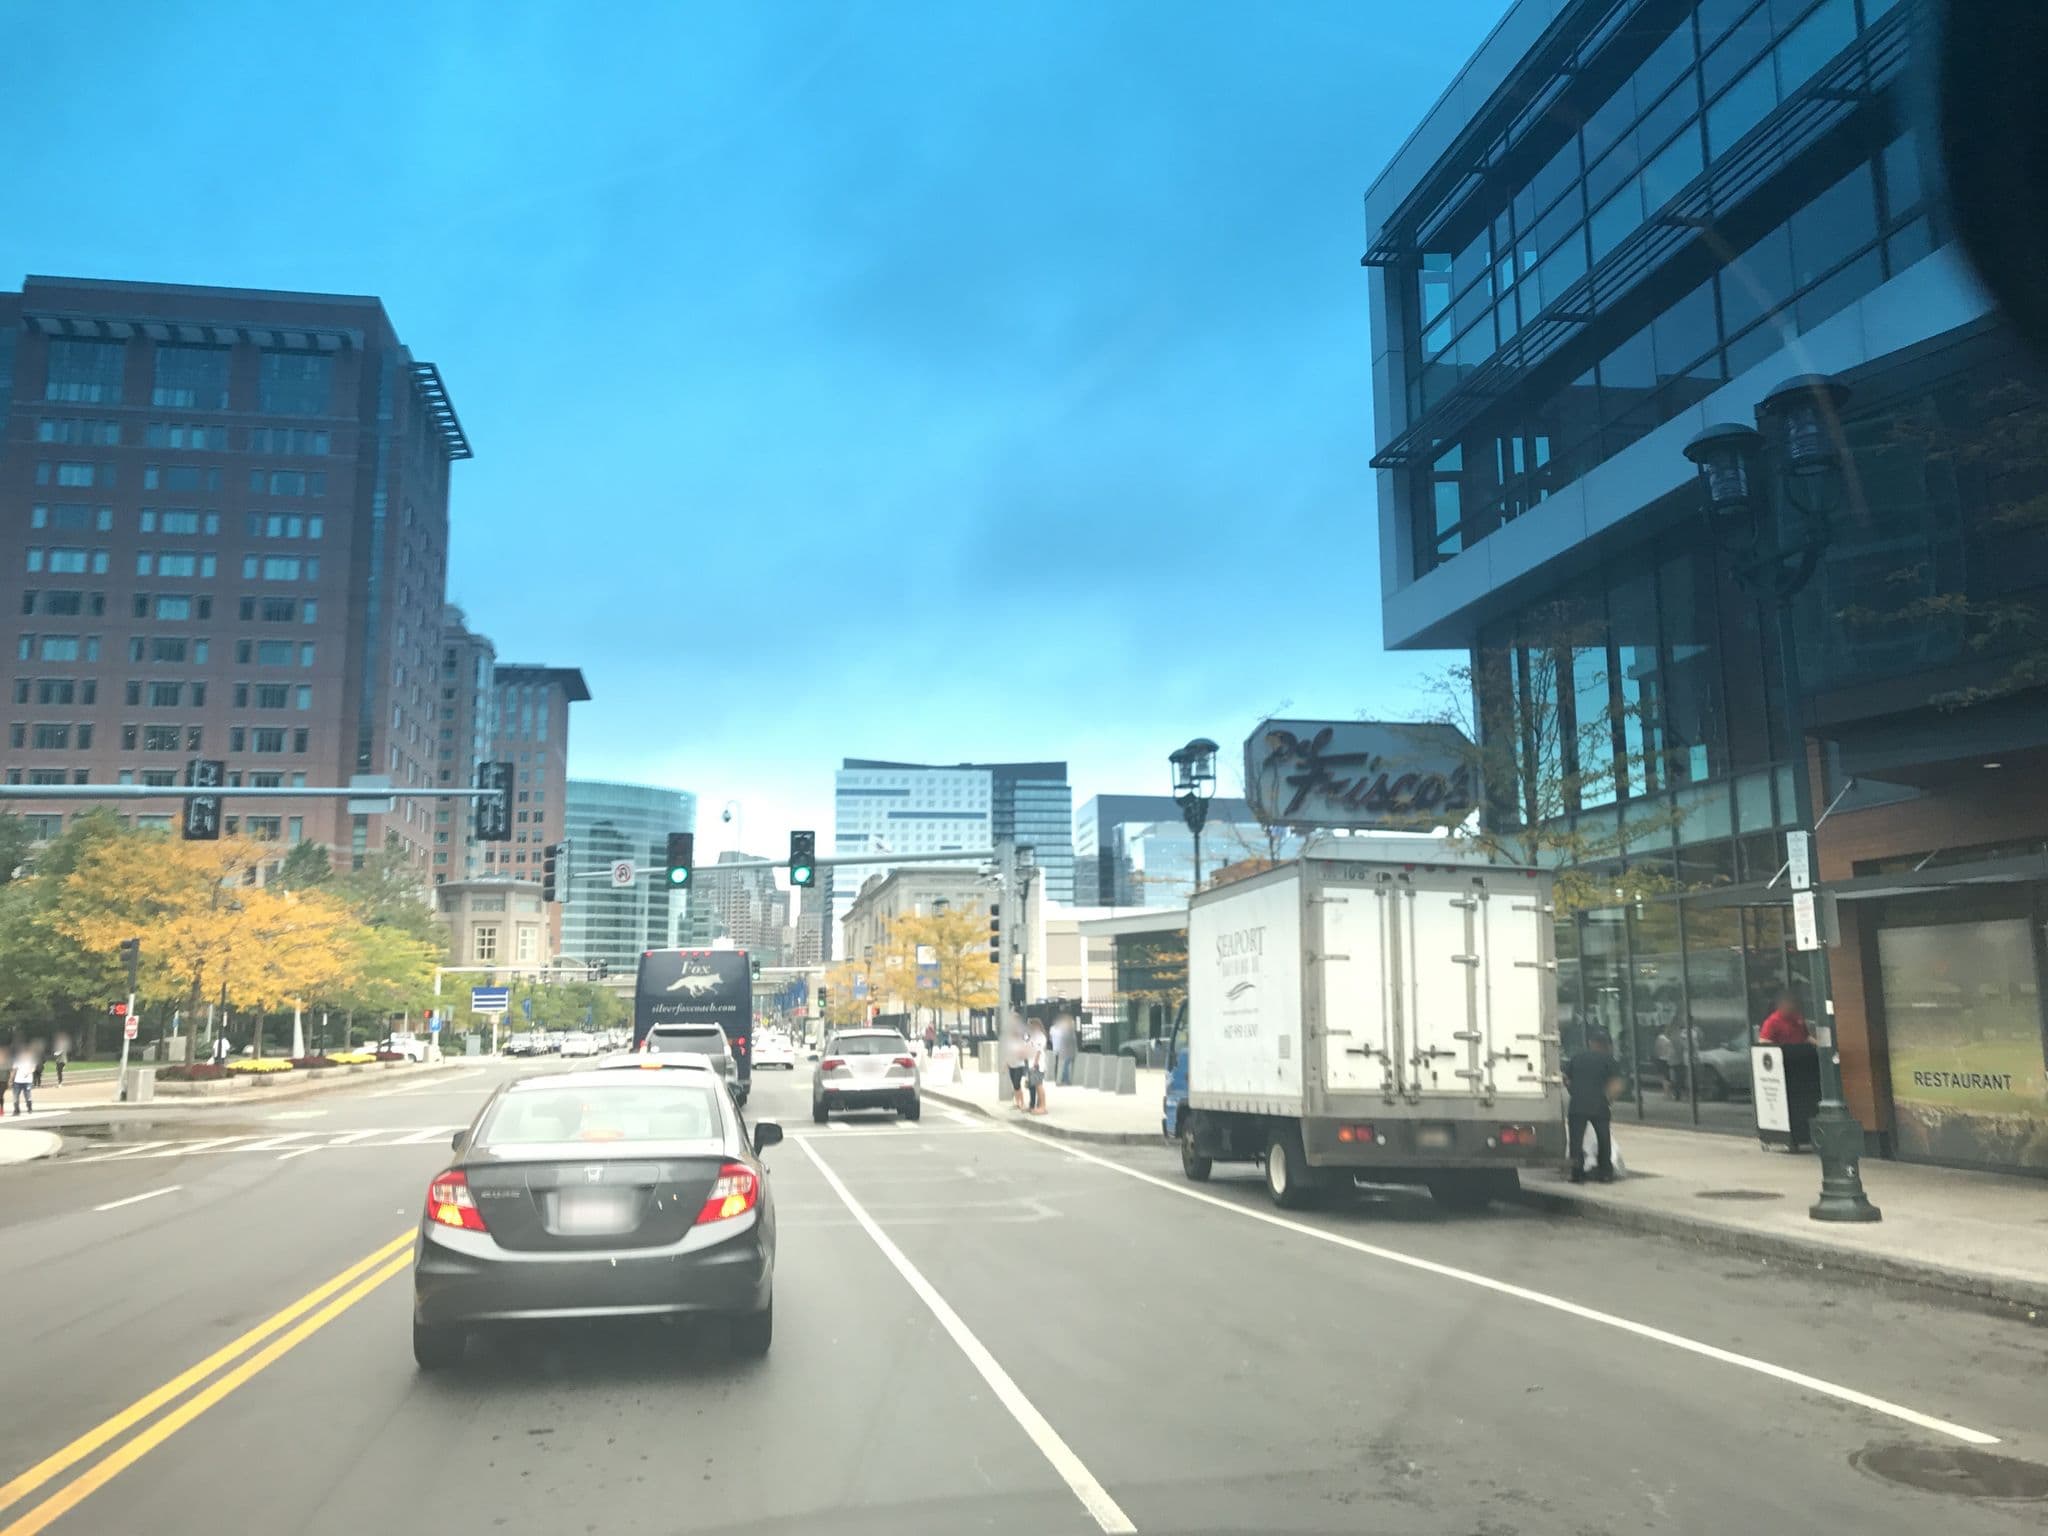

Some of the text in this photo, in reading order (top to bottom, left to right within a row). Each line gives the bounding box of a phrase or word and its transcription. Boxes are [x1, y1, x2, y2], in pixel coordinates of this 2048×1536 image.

[1284, 752, 1471, 816] Frisco's
[681, 960, 711, 975] Fox
[1913, 1071, 2013, 1091] RESTAURANT
